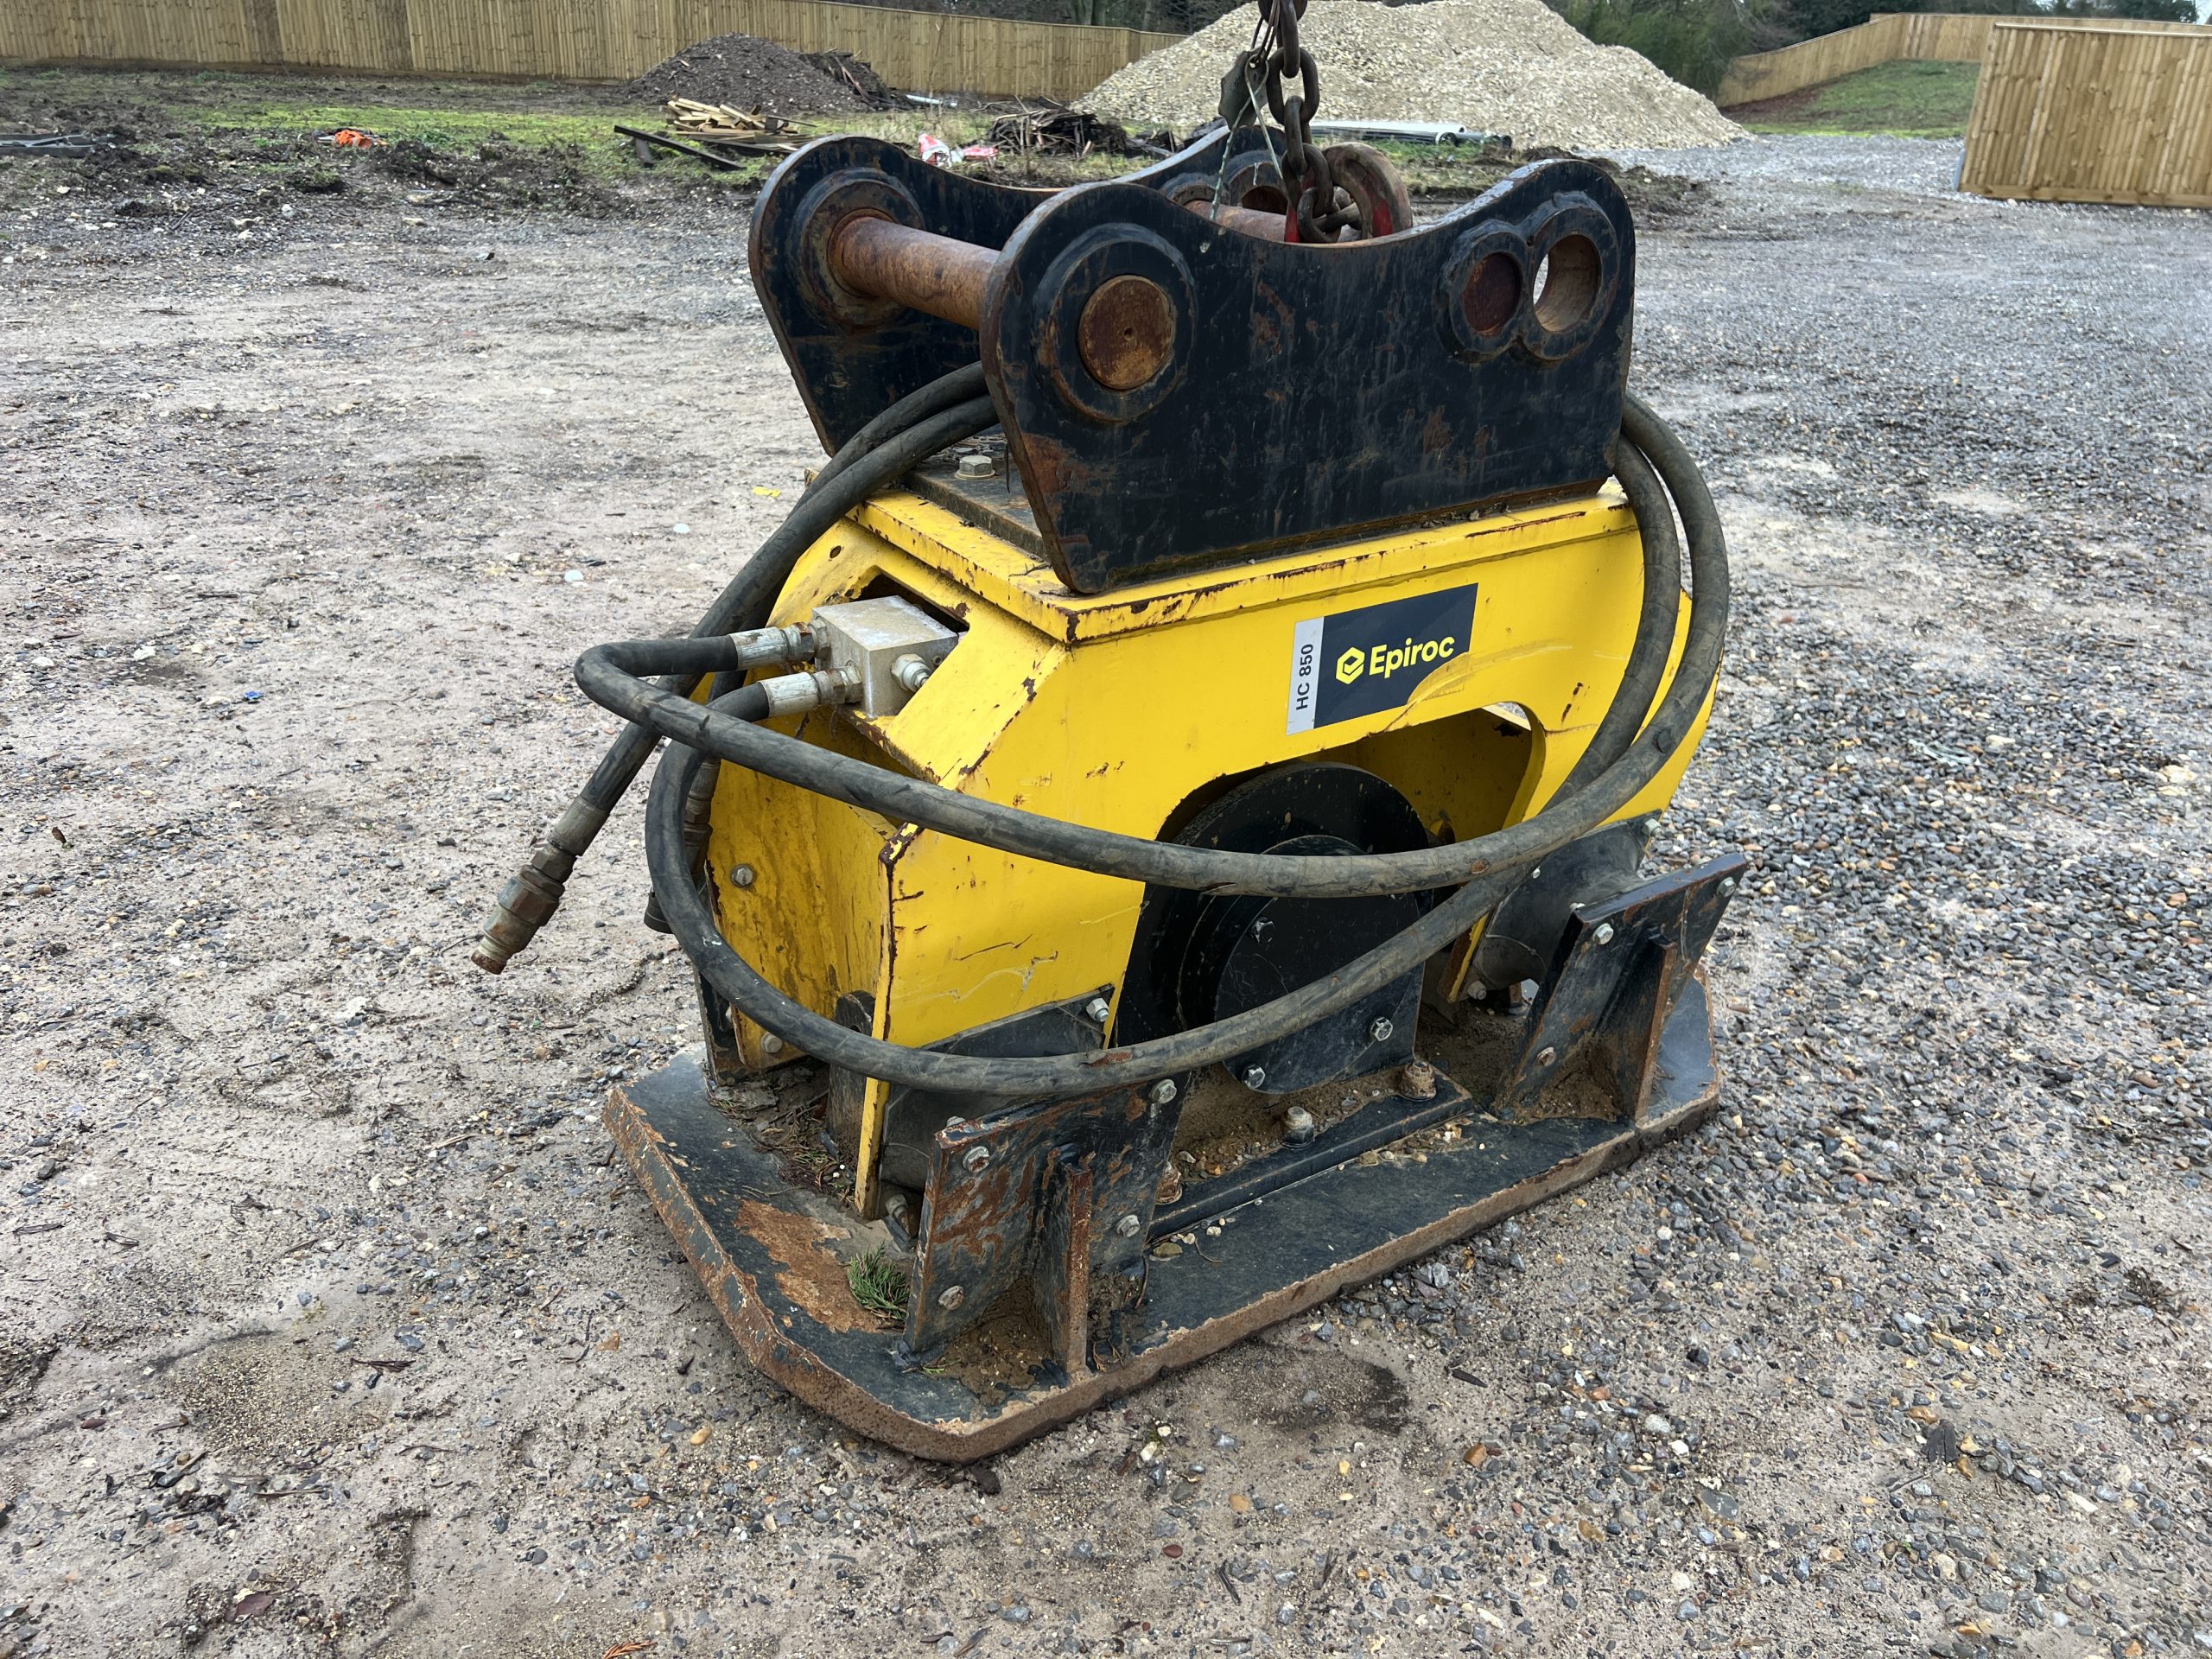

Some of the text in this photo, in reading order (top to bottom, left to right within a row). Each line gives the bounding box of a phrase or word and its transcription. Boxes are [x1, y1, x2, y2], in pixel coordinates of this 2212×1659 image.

[1295, 644, 1314, 710] HC 850
[1369, 636, 1455, 678] Epiroc
